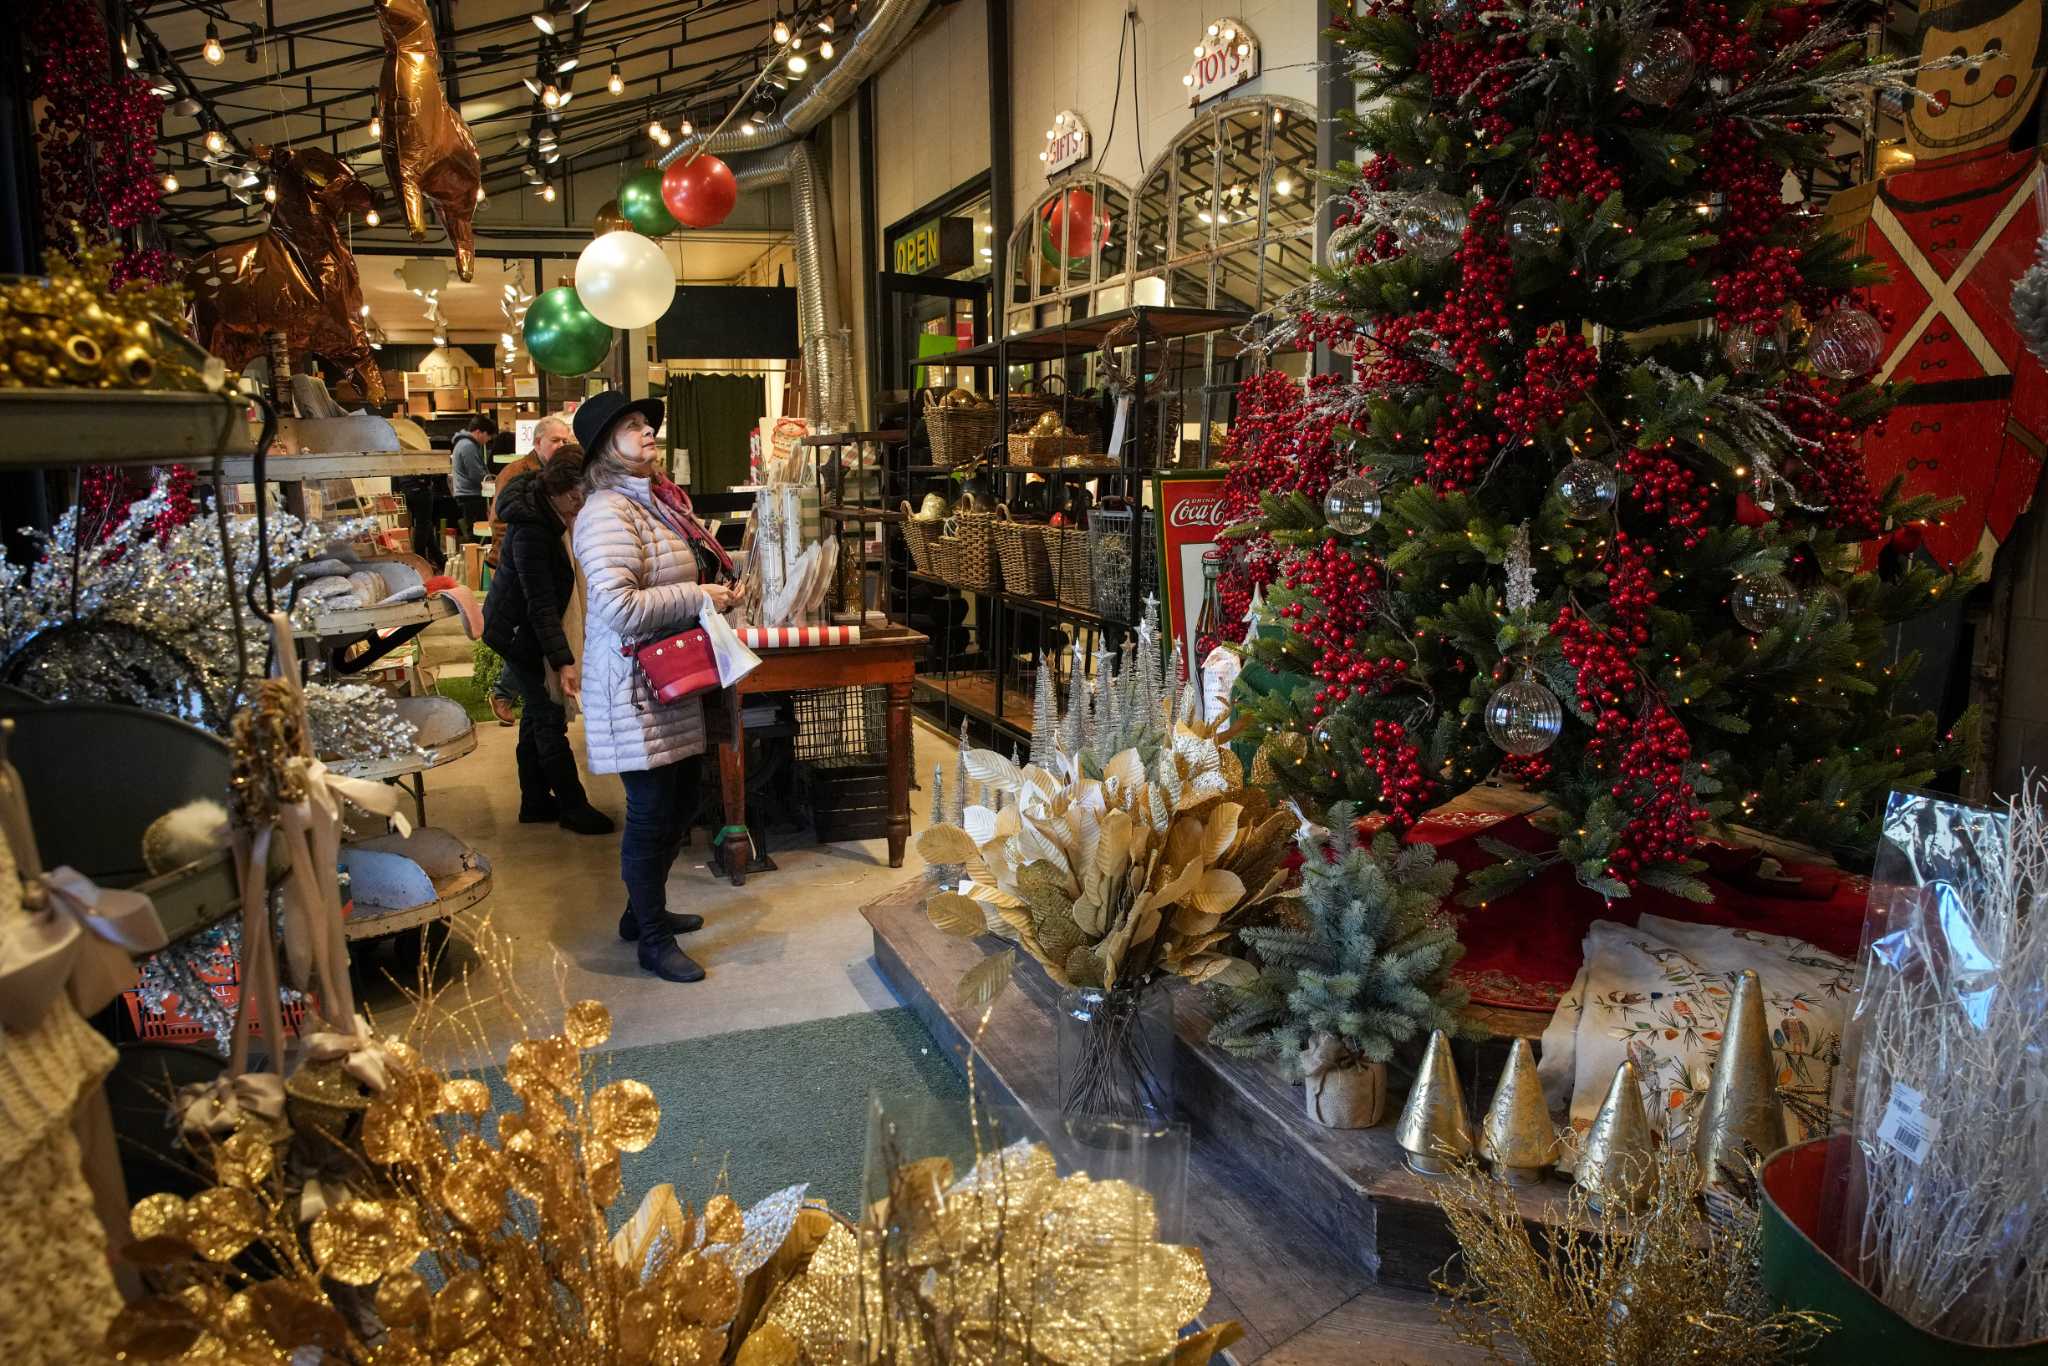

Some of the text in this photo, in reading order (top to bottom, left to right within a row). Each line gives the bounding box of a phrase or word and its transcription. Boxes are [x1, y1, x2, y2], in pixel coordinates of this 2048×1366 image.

[1196, 44, 1241, 89] TOYS
[1049, 132, 1079, 164] GIFTS
[896, 228, 937, 273] OPEN
